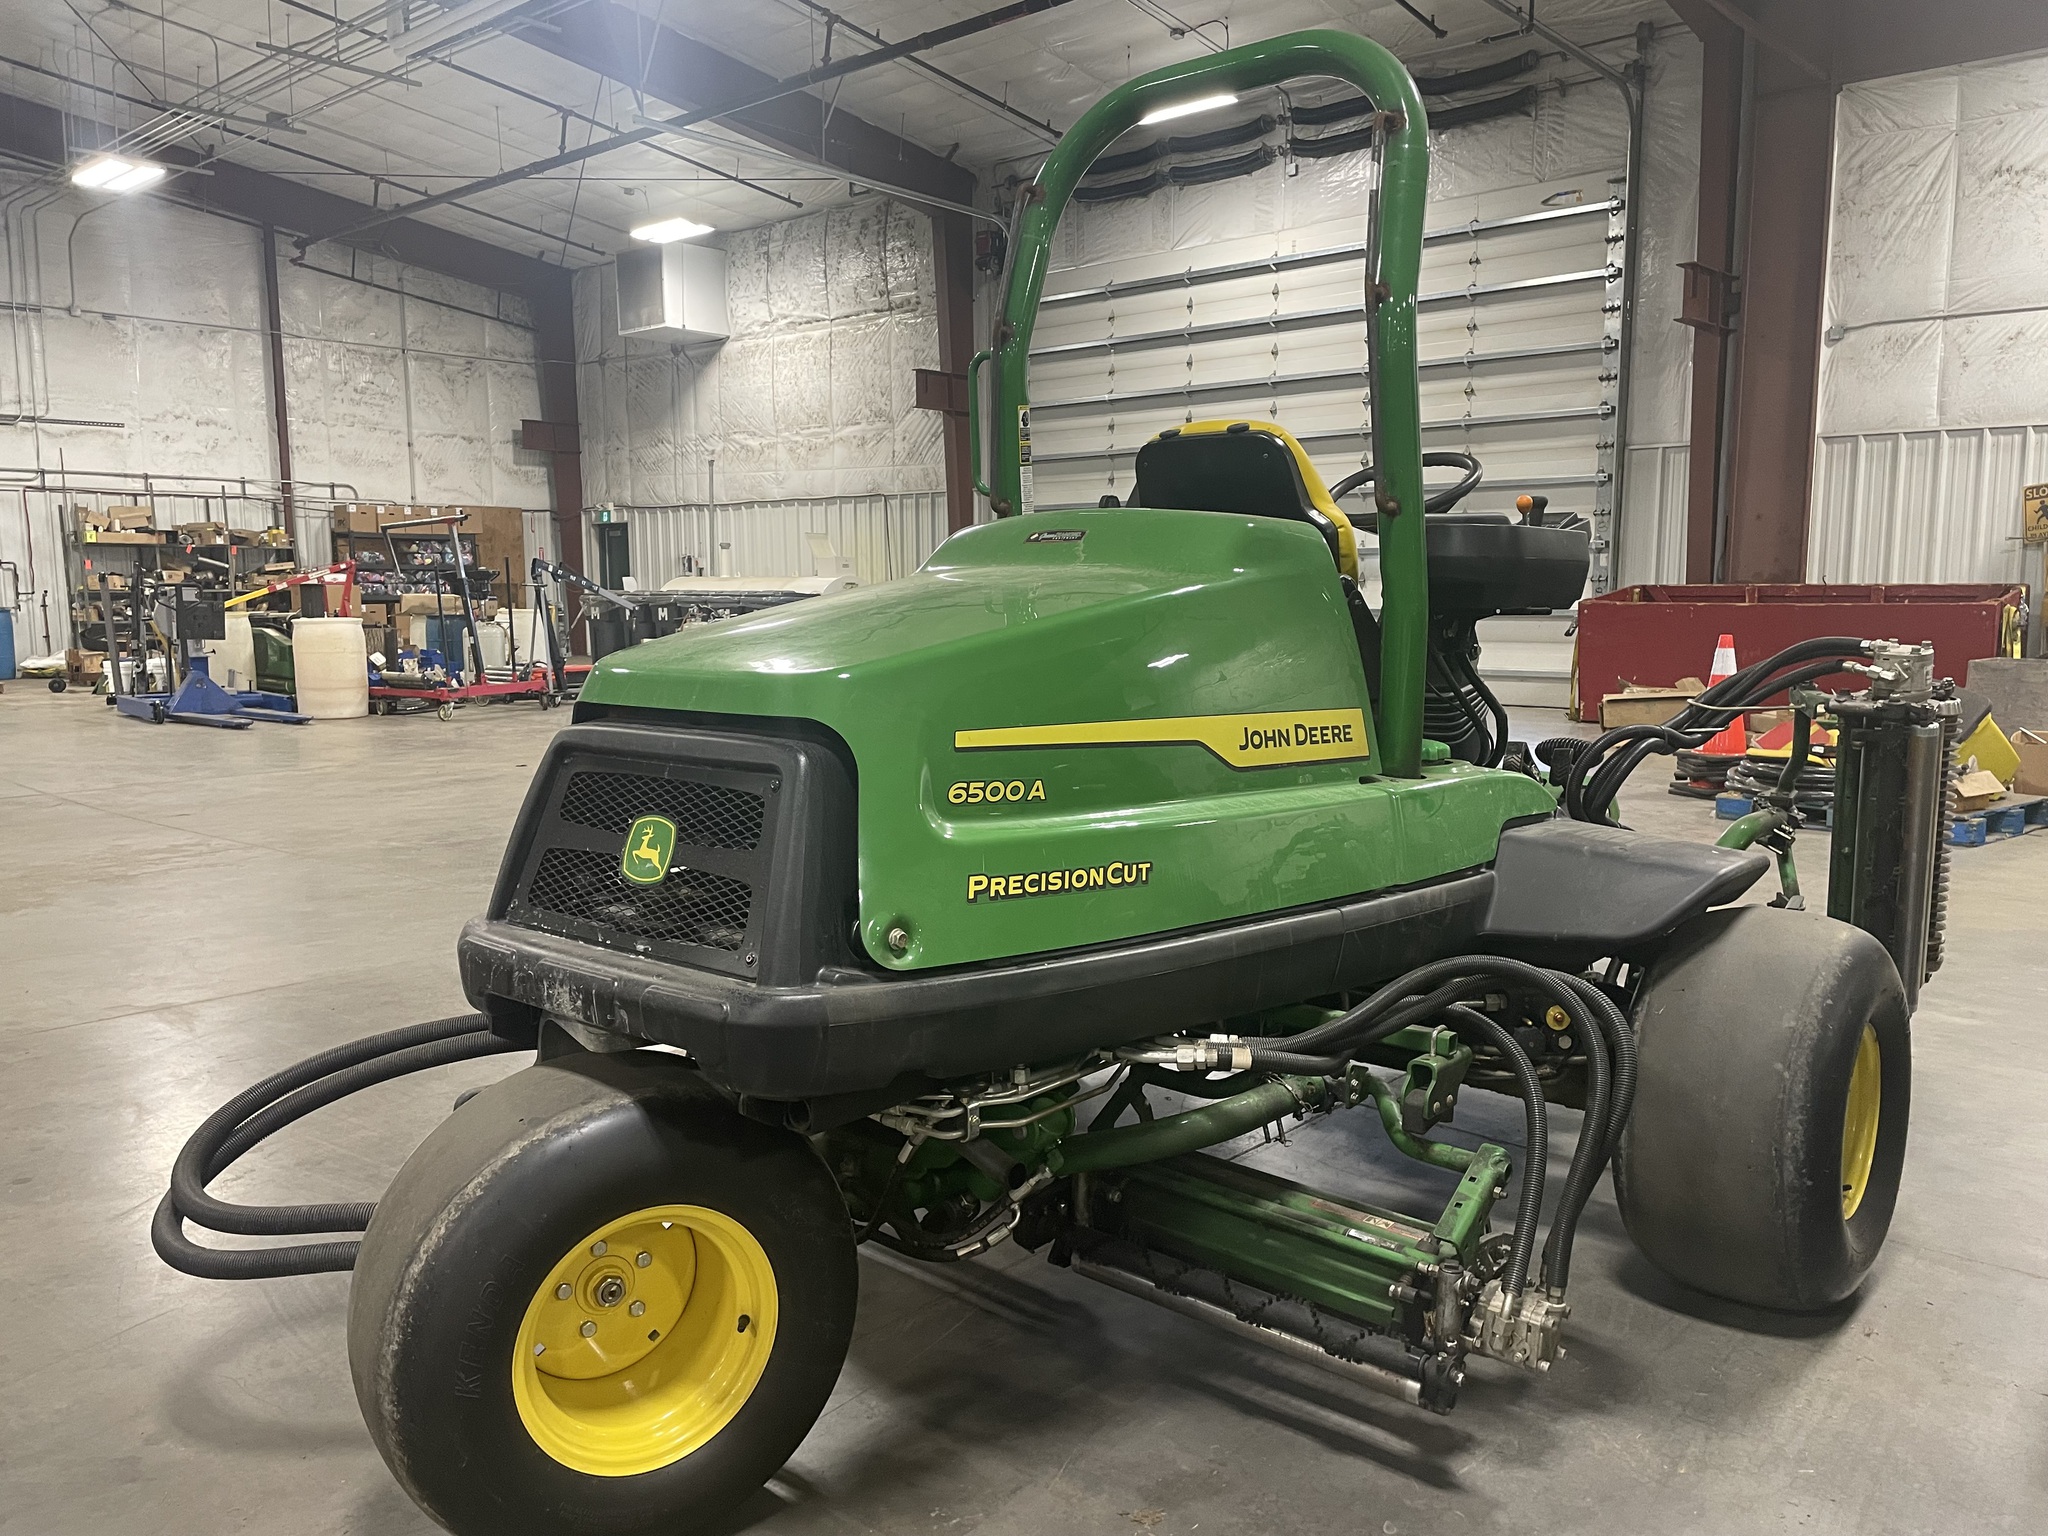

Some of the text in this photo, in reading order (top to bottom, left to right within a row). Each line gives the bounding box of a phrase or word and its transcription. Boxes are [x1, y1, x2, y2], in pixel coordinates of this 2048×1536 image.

[2026, 487, 2048, 499] SLO
[657, 607, 668, 621] M
[1239, 724, 1353, 750] JOHN DEERE
[967, 861, 1152, 902] PRECISIONCUT
